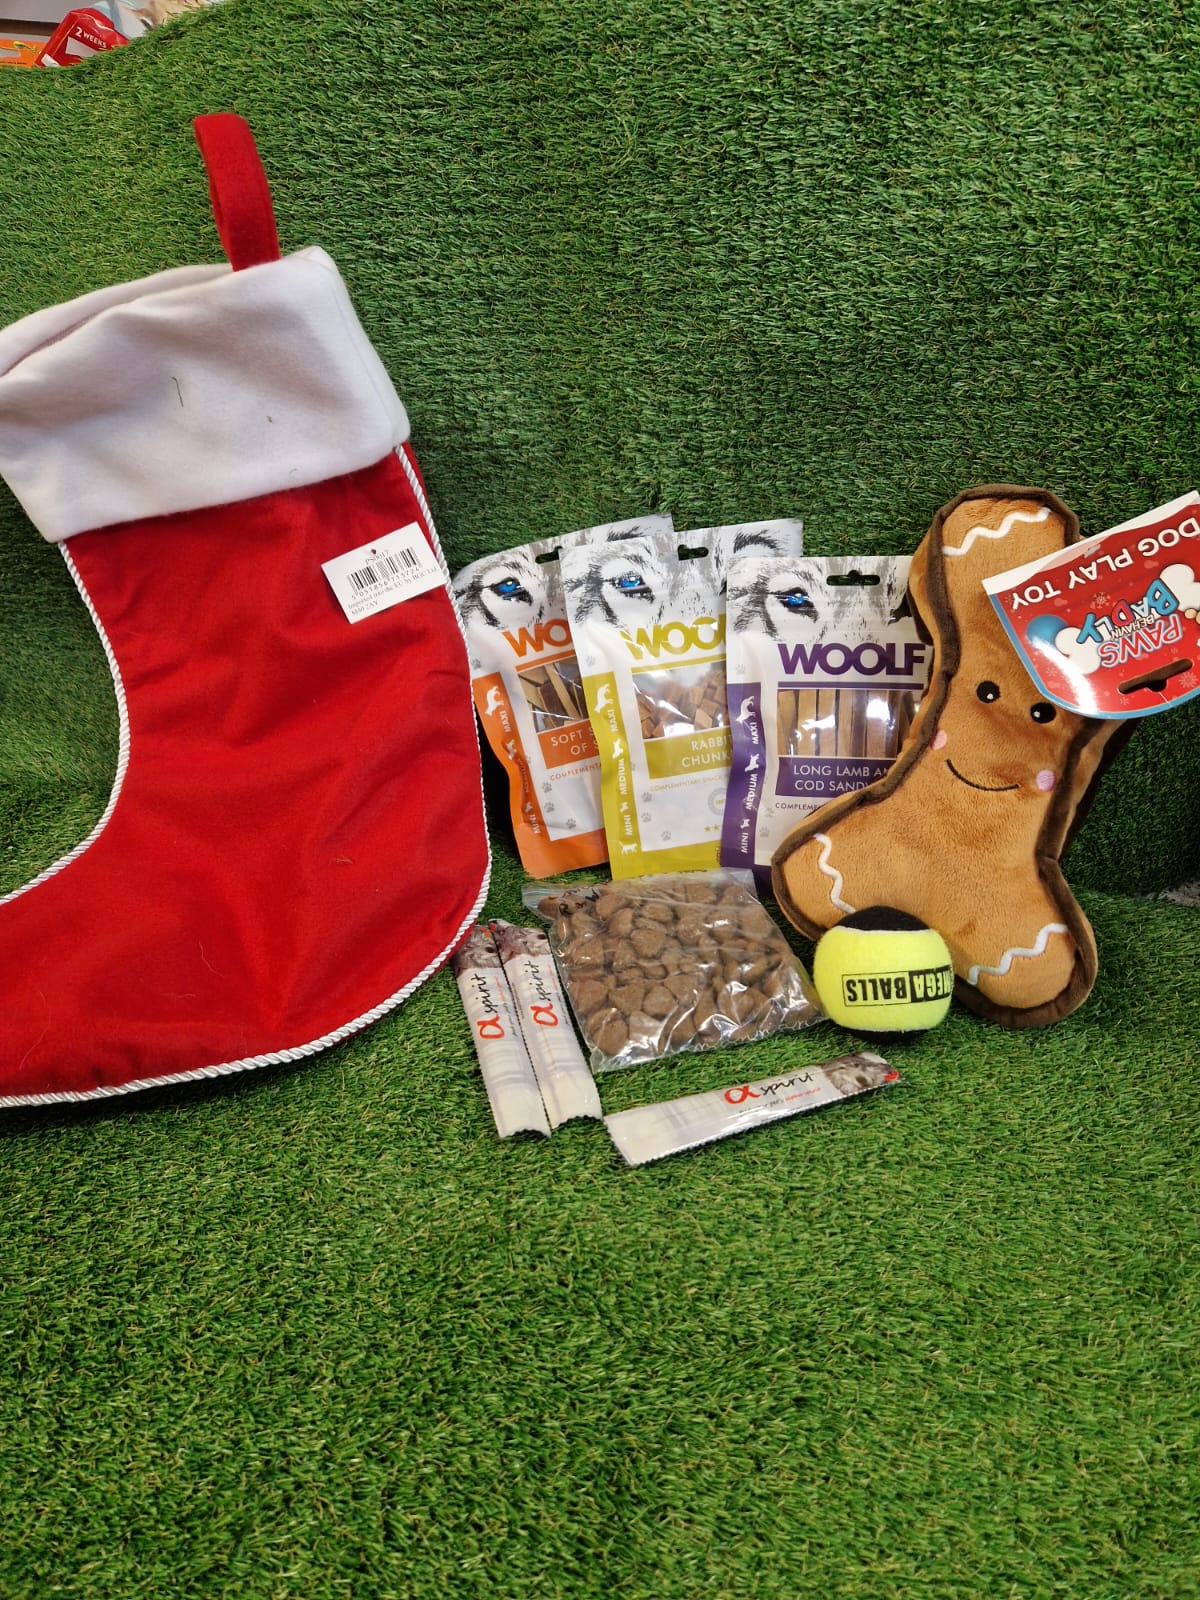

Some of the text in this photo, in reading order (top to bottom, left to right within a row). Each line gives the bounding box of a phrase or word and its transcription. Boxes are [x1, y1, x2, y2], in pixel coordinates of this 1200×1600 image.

[75, 26, 107, 48] 2 WEEKS
[1012, 517, 1200, 610] DOG PLAY TOY
[1076, 578, 1180, 644] BADLY
[1098, 614, 1183, 667] PAWS
[777, 642, 926, 676] WOOLF
[499, 709, 512, 733] MAXI
[608, 708, 620, 733] MAXI
[749, 721, 759, 745] MAXI
[550, 729, 583, 747] SOFT
[570, 742, 588, 756] OF
[618, 759, 628, 796] MEDIUM
[793, 764, 832, 776] LONG
[836, 766, 870, 777] LAMB
[745, 773, 759, 810] MEDIUM
[794, 779, 825, 791] COD
[623, 814, 634, 837] MINI
[741, 832, 750, 855] MINI
[524, 959, 552, 1002] spirit
[845, 976, 908, 1002] BALLS
[470, 973, 498, 1014] spirit
[760, 1071, 815, 1096] spirit
